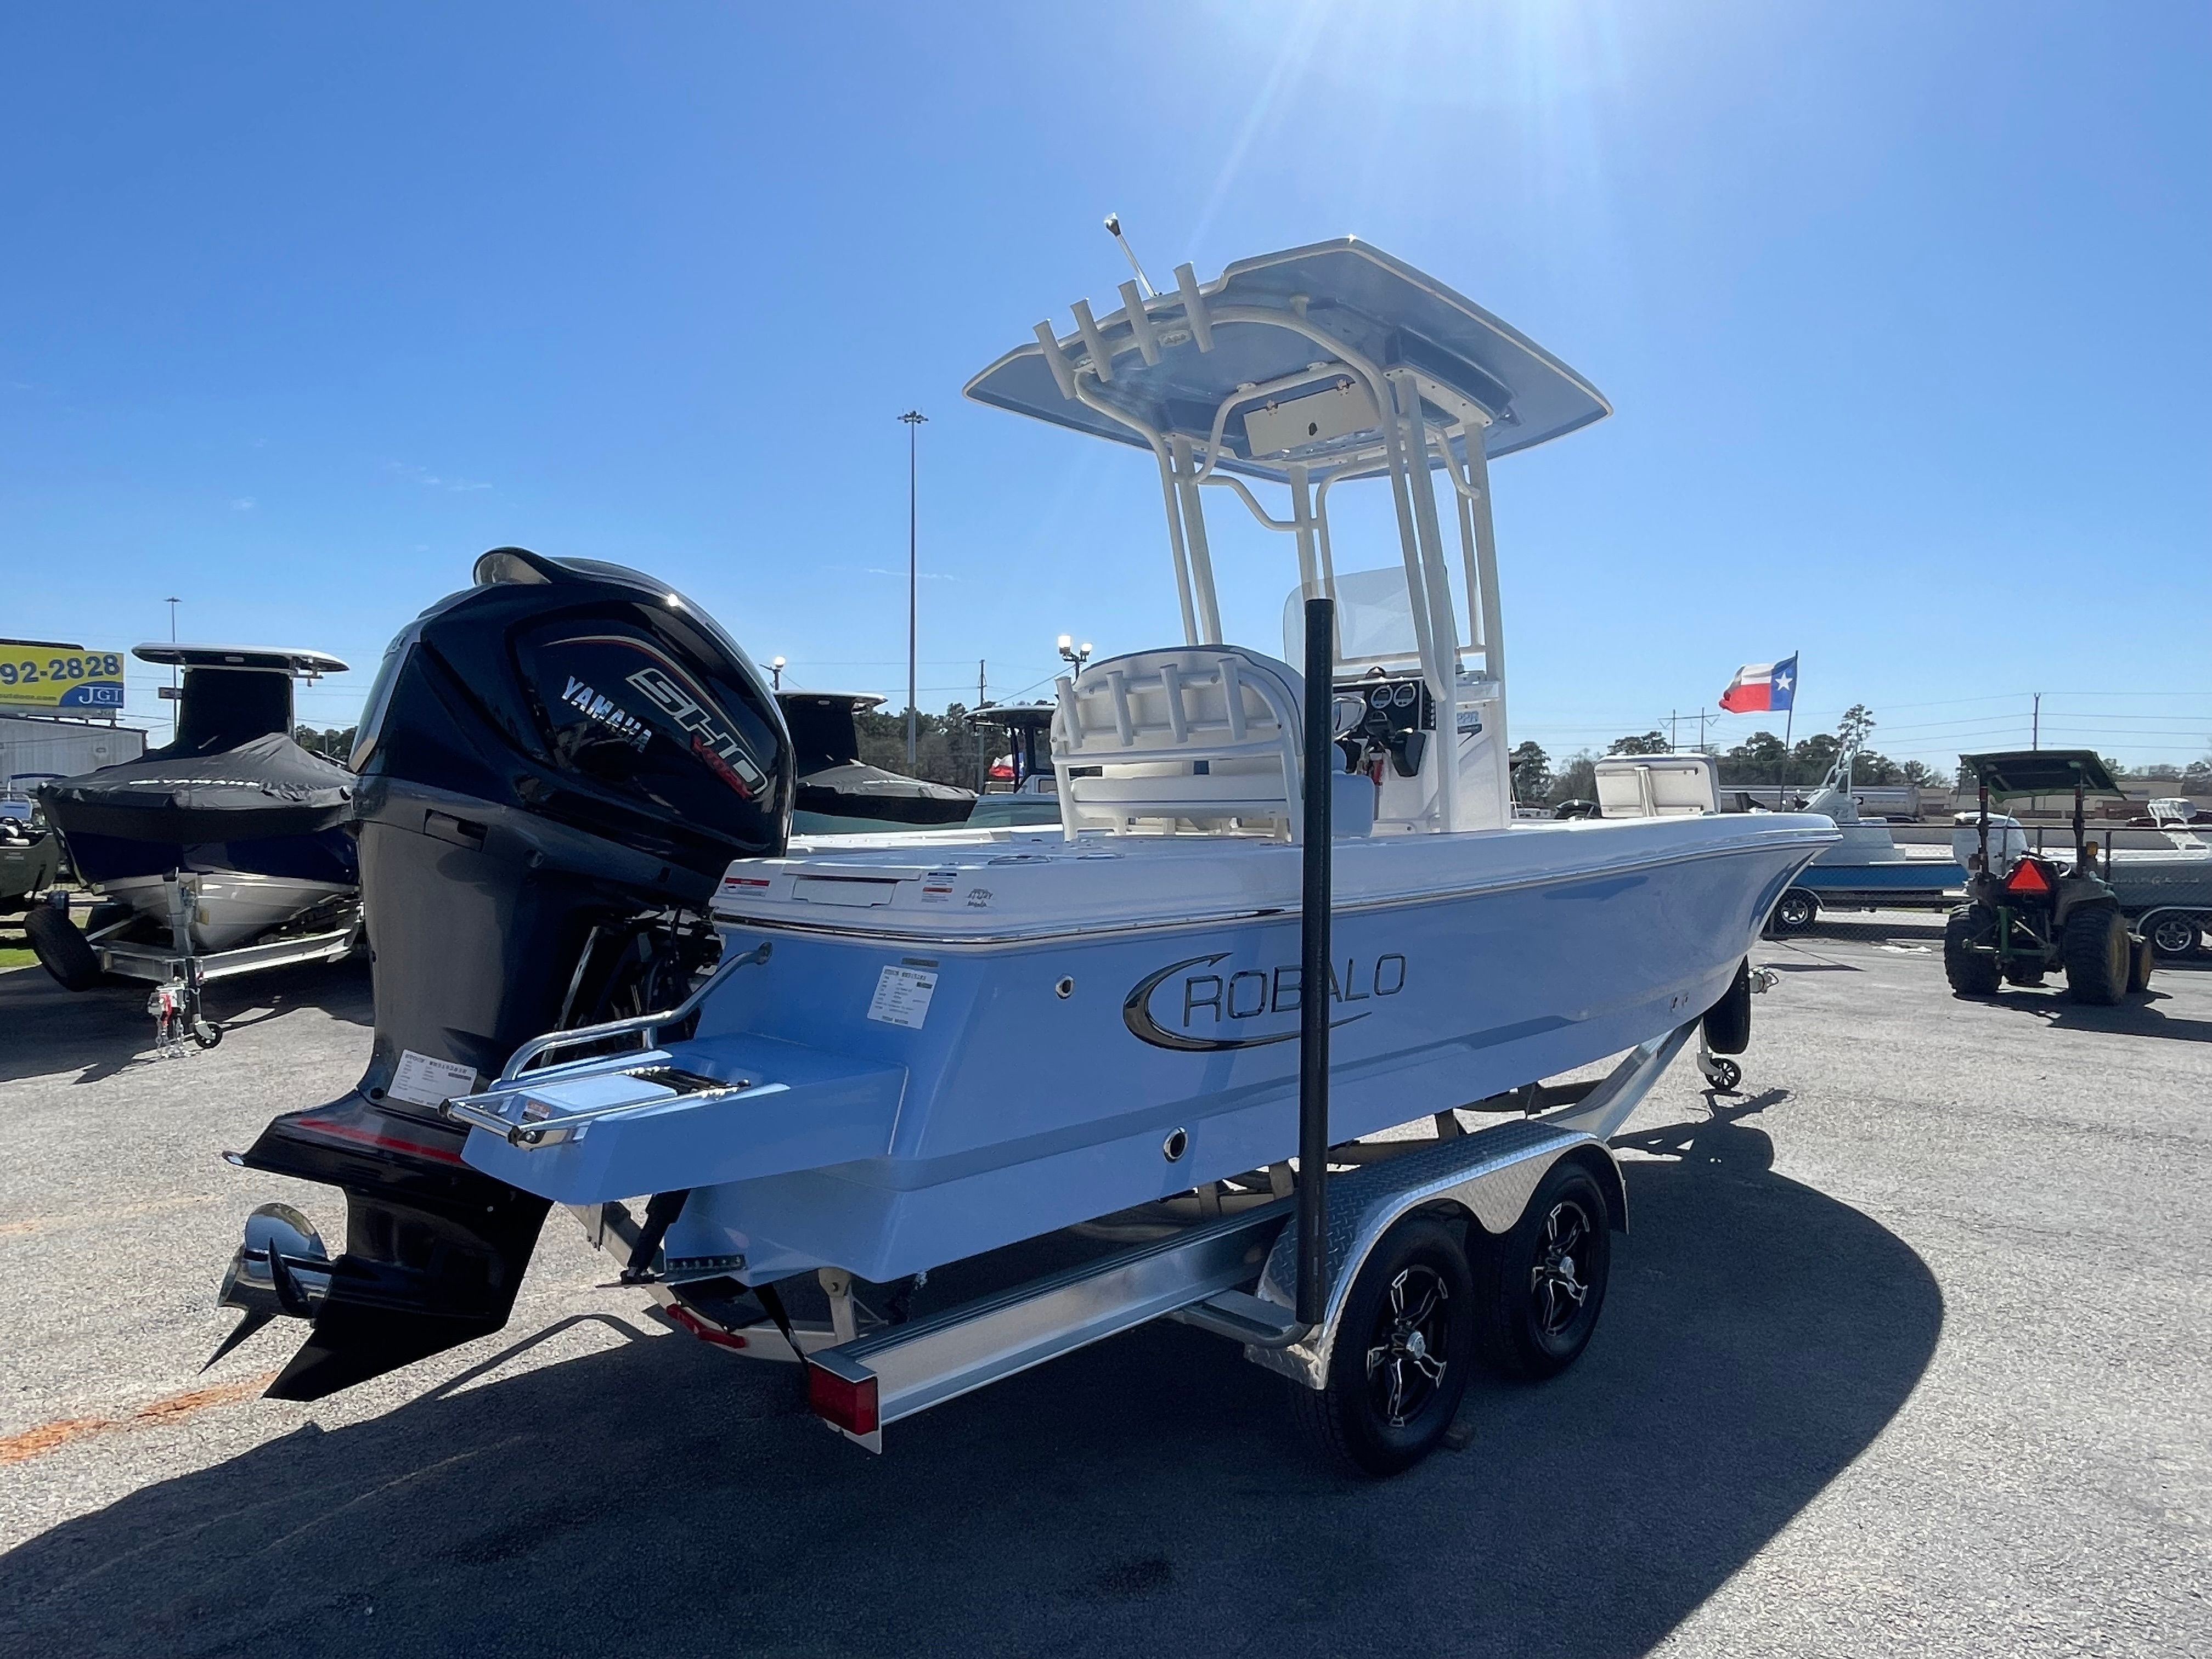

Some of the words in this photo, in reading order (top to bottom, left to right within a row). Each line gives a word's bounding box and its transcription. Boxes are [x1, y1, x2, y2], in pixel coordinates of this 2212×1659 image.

[78, 687, 120, 704] JGI
[561, 675, 652, 754] YAMAHA
[625, 667, 768, 795] SHO
